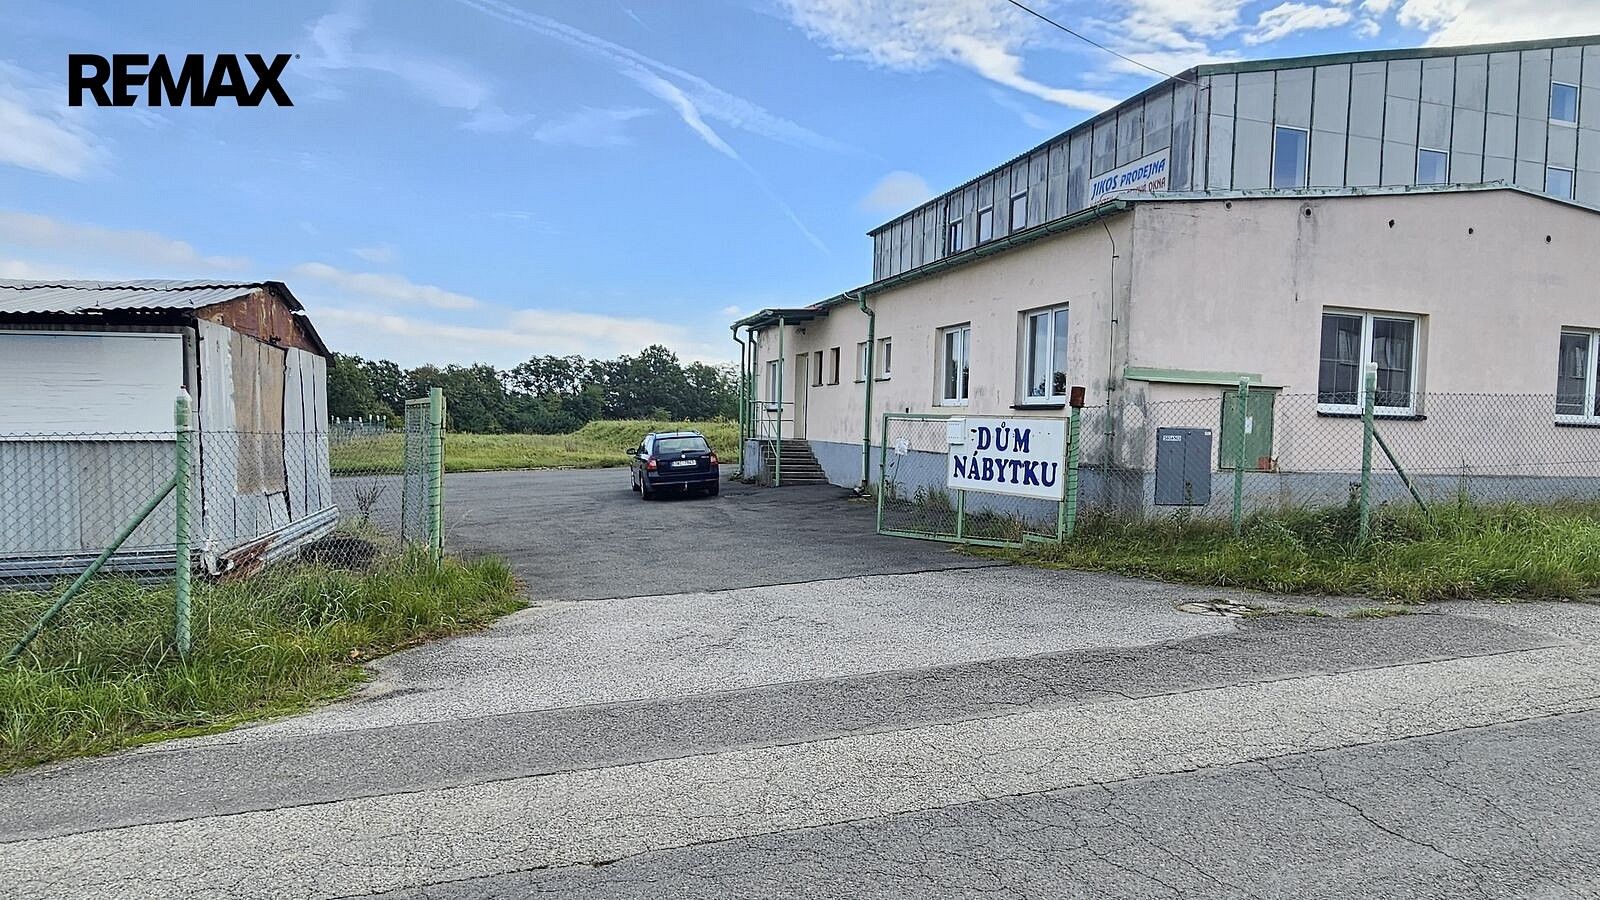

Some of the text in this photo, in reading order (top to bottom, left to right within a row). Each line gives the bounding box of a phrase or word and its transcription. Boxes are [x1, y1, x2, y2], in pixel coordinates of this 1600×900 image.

[1091, 158, 1166, 200] JIKOS PRODEJNA
[1148, 177, 1166, 193] OKNA
[976, 421, 1031, 453] DŮM
[953, 451, 1057, 487] NÁBYTKU
